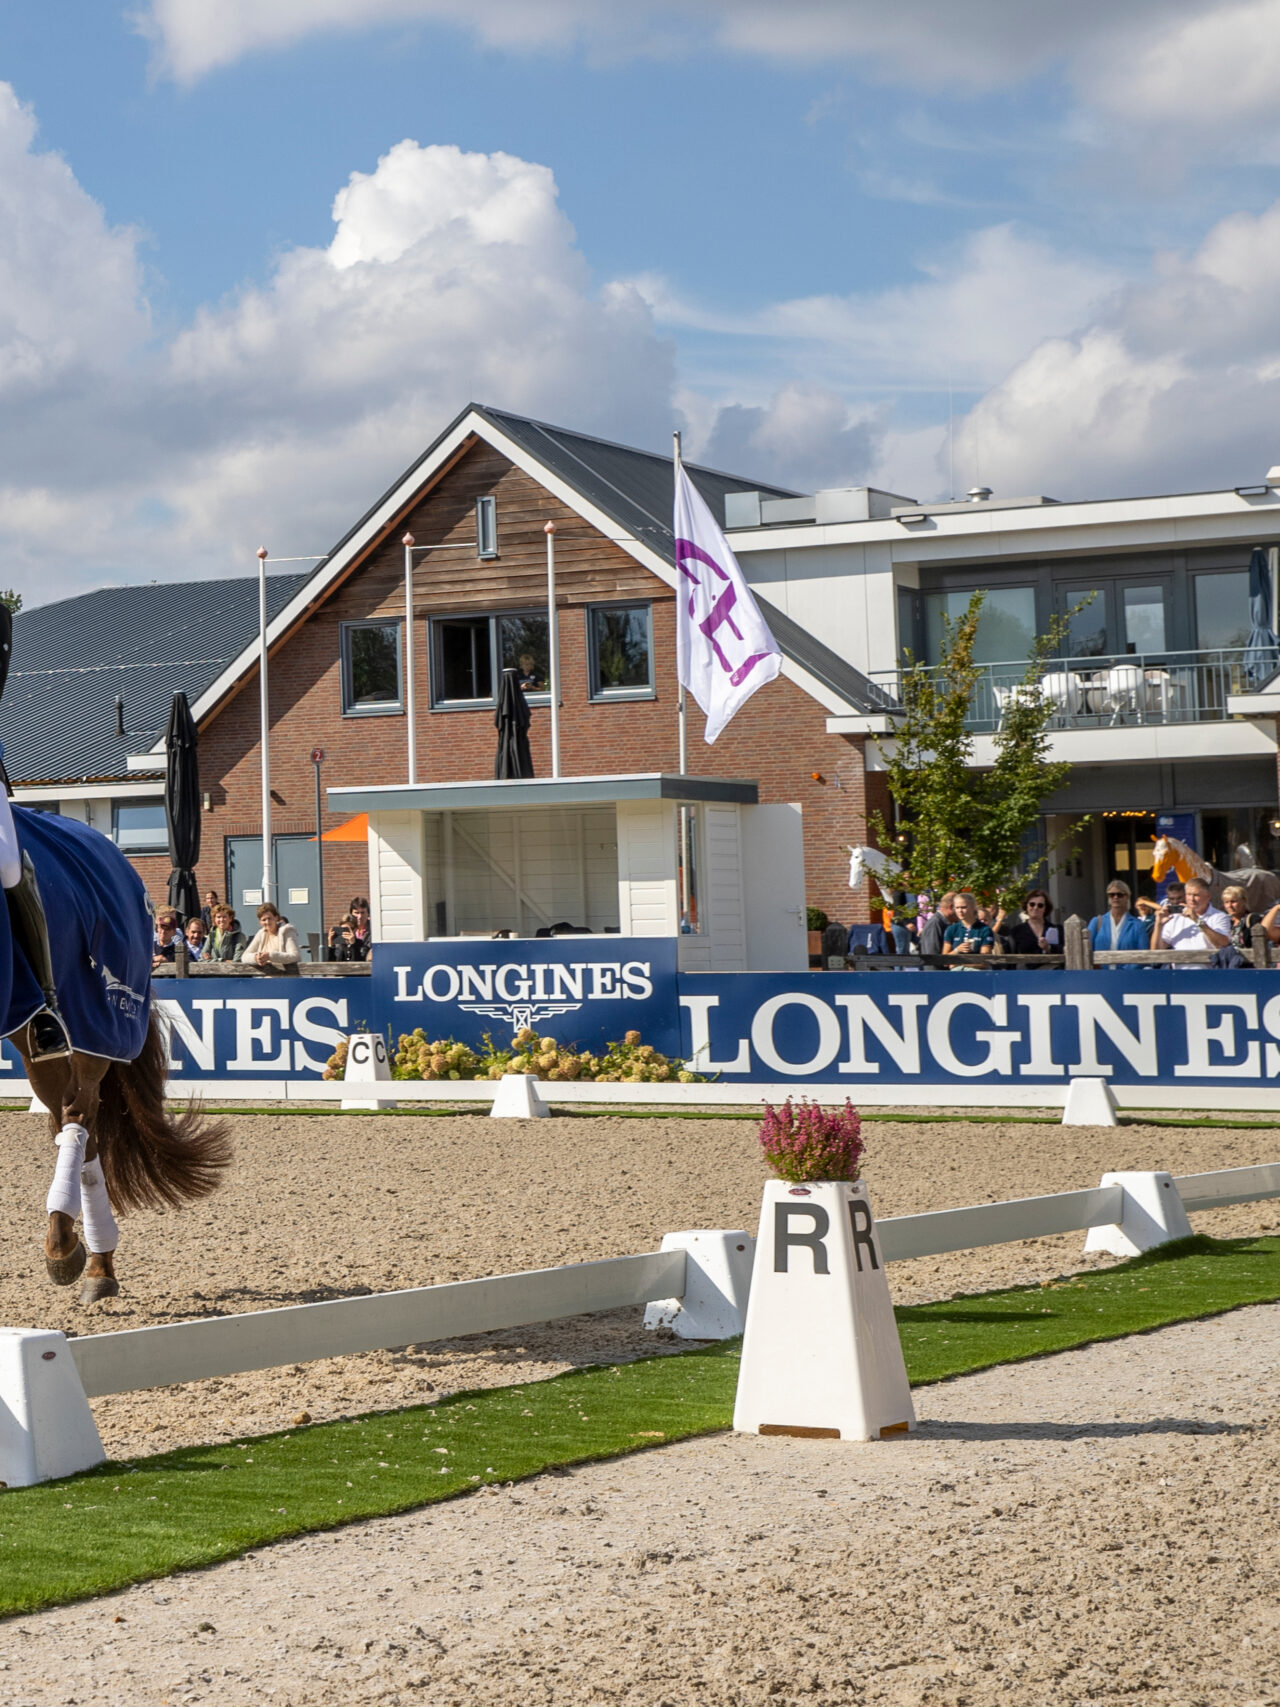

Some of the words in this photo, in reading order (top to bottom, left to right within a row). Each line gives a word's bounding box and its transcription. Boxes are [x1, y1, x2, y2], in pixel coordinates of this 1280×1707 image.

[315, 752, 321, 761] 2
[393, 961, 653, 1002] LONGINES
[352, 1041, 370, 1064] C
[375, 1040, 385, 1063] C
[679, 991, 1280, 1078] LONGINE
[773, 1202, 830, 1275] R
[848, 1199, 880, 1272] R
